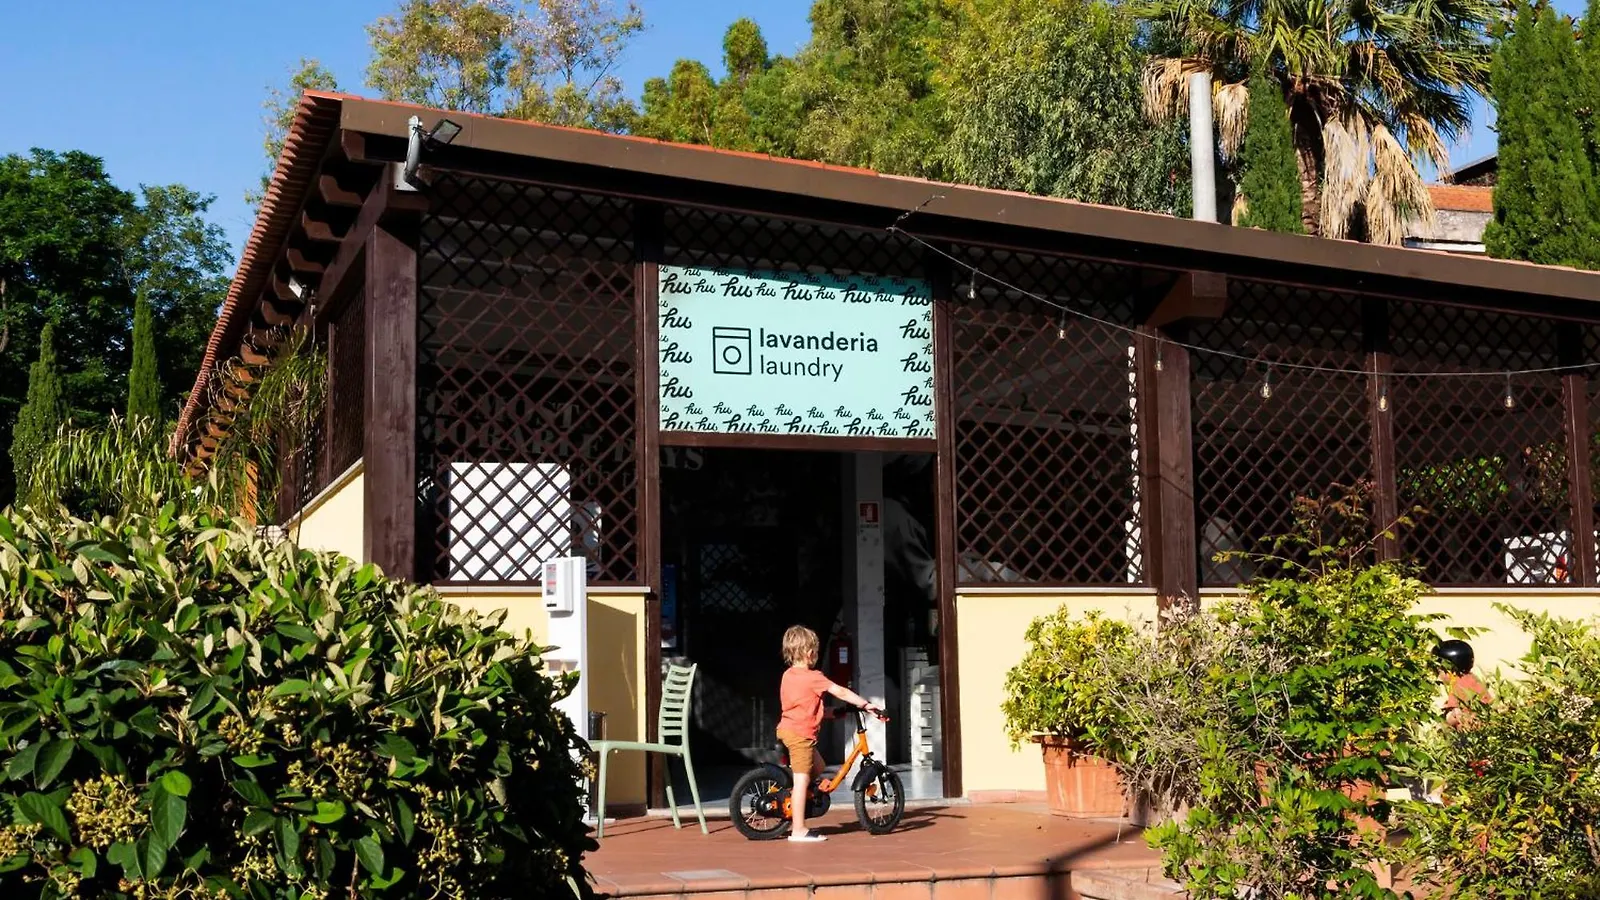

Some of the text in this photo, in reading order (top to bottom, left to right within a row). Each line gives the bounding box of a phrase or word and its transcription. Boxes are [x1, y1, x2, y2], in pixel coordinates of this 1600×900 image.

[661, 273, 931, 306] hu hu hu hu hu hu hu hu hu
[660, 308, 692, 329] hu
[760, 328, 878, 352] lavanderia
[899, 319, 930, 340] hu
[660, 342, 693, 363] hu
[900, 352, 931, 373] hu
[761, 354, 843, 382] laundry
[661, 377, 693, 398] hu
[900, 386, 932, 406] hu
[684, 402, 703, 414] hu
[713, 402, 732, 414] hu
[746, 404, 765, 416] hu
[774, 404, 793, 416] hu
[807, 406, 825, 418] hu
[834, 405, 852, 418] hu
[866, 408, 884, 420] hu
[893, 407, 911, 419] hu
[817, 420, 839, 434] hu
[877, 422, 898, 436] hu
